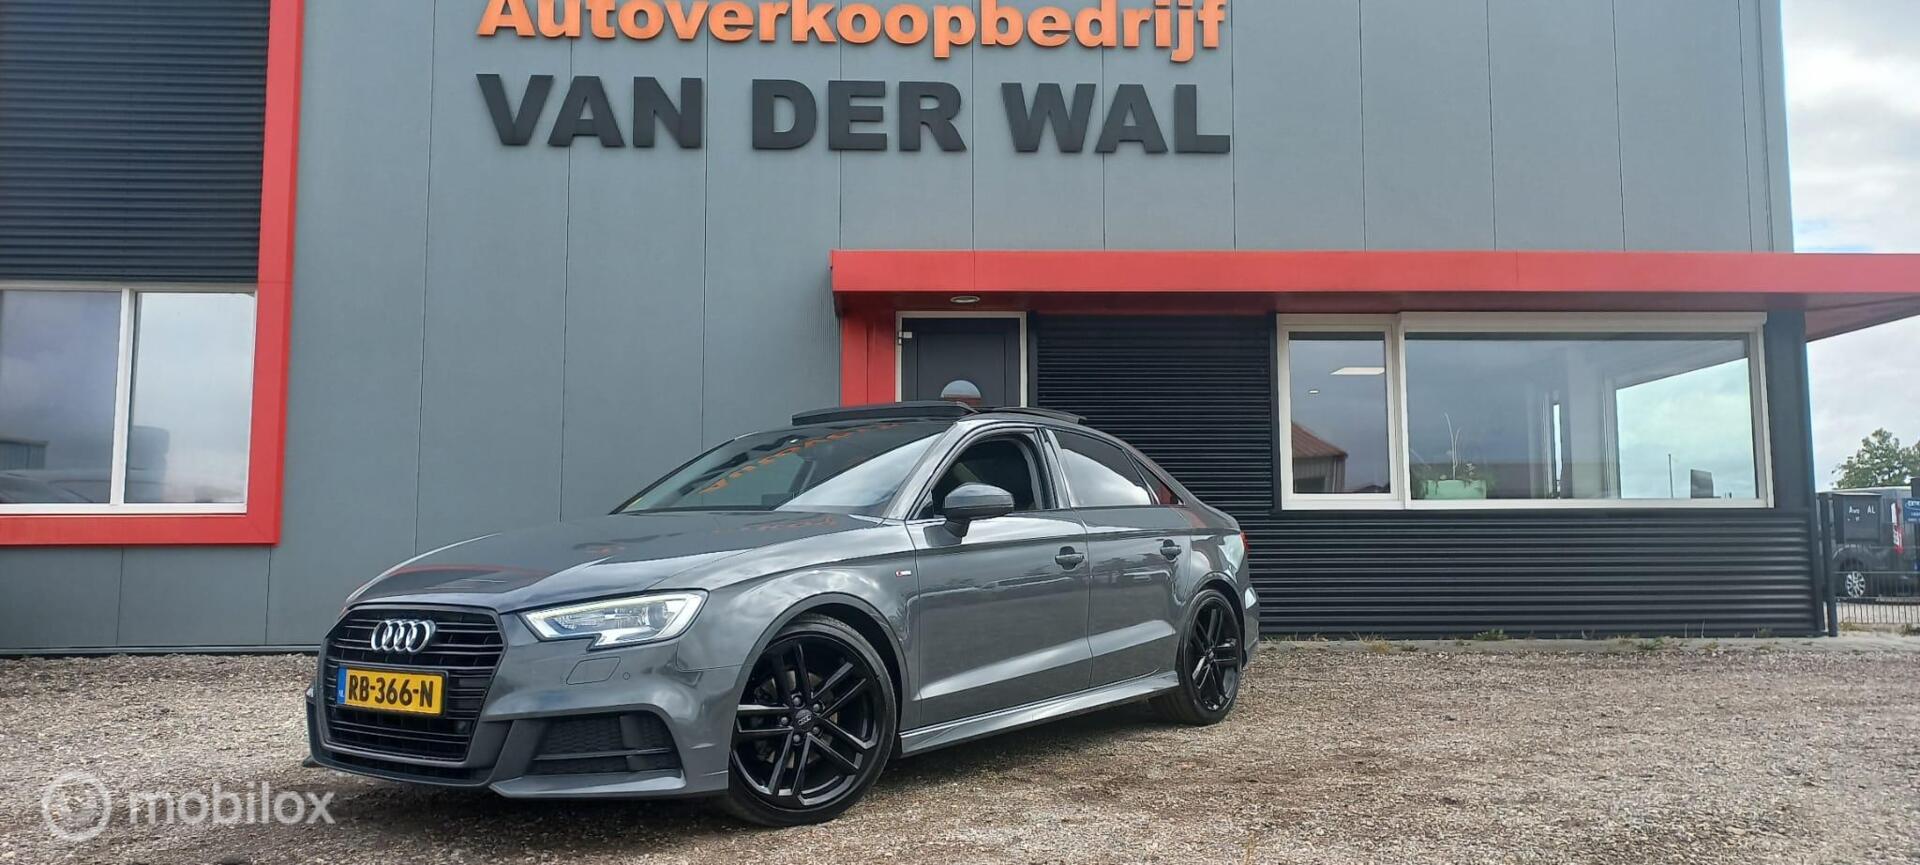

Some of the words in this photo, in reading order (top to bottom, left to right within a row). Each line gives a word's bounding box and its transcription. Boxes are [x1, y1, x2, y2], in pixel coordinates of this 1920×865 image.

[476, 0, 1225, 62] Autoverkoopbedrijf
[476, 73, 704, 149] VAN
[751, 79, 967, 152] DER
[1001, 83, 1231, 154] WAL
[348, 674, 434, 708] RB-366-N
